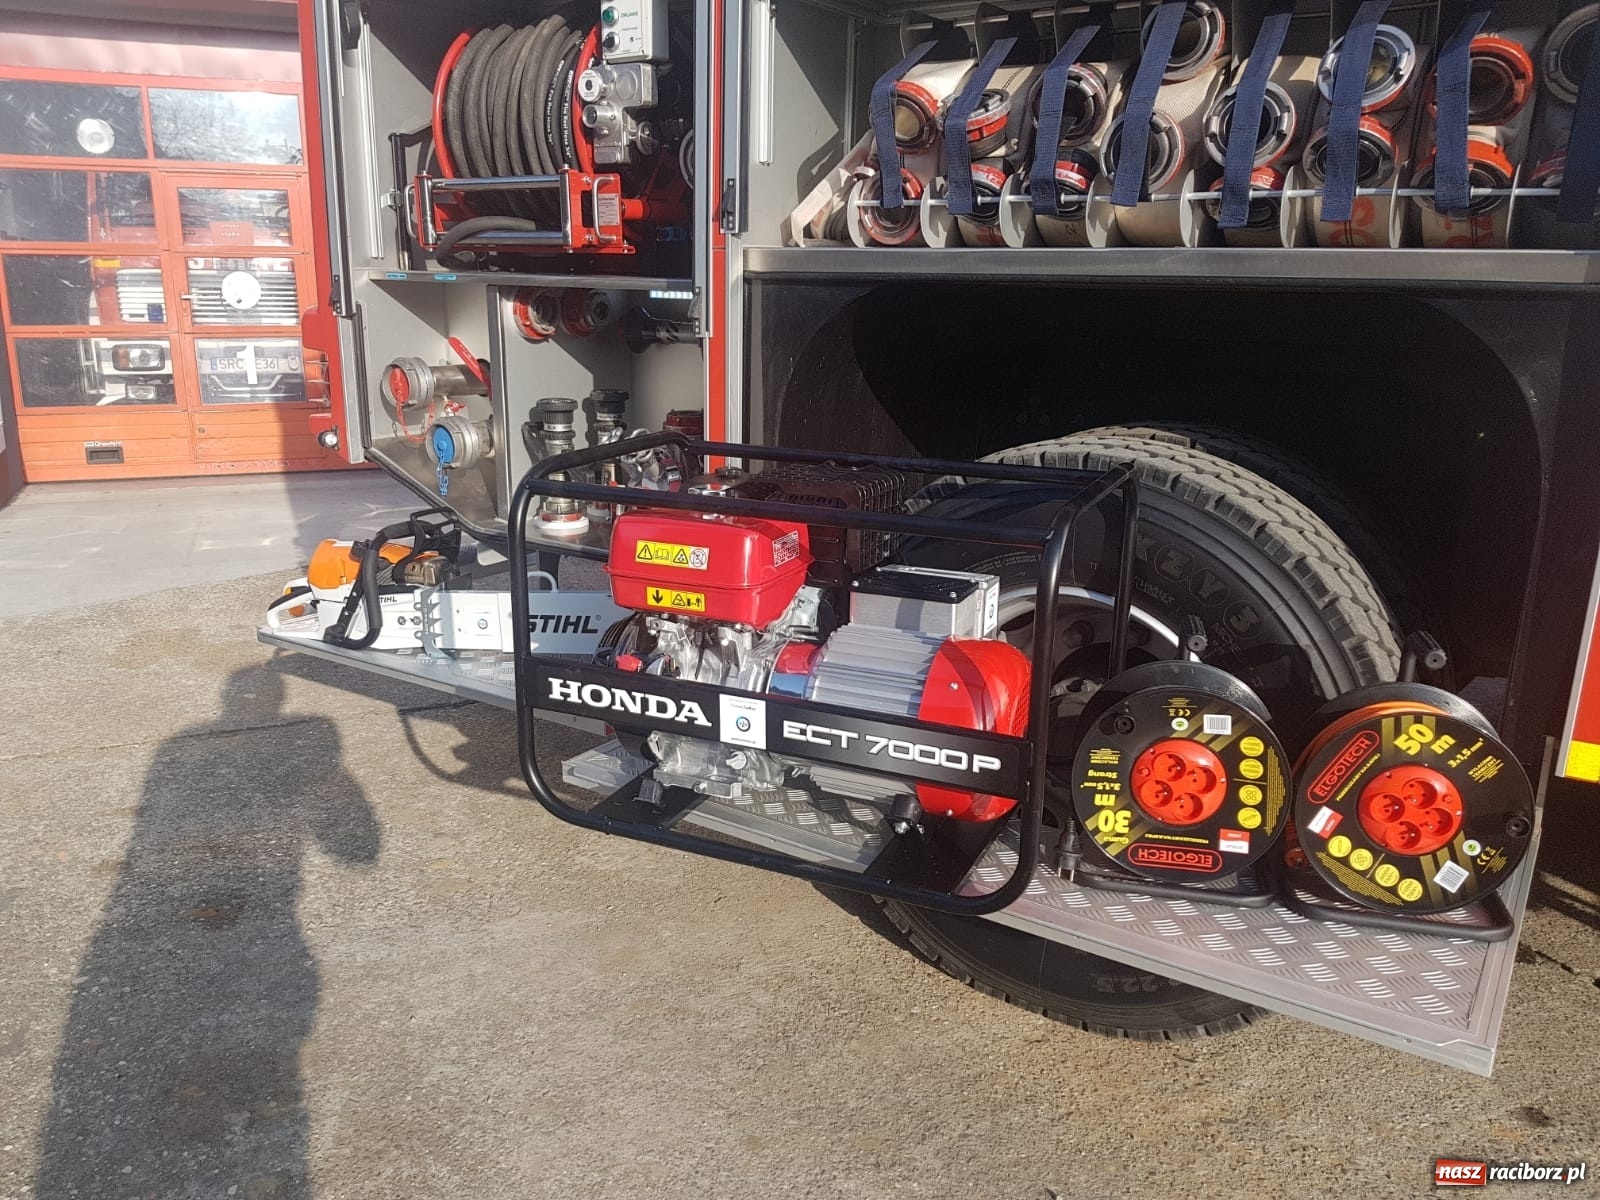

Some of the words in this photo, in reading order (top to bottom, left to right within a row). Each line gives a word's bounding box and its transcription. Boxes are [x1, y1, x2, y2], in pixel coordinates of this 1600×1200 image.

[219, 358, 244, 370] SRC
[236, 344, 258, 385] 1
[377, 594, 397, 603] TIHL
[527, 614, 599, 634] STIHL
[548, 677, 713, 727] HONDA
[783, 719, 859, 749] ECT
[1393, 723, 1434, 755] 50
[1430, 734, 1456, 755] m
[1313, 735, 1372, 797] ELGOTECH
[1094, 793, 1116, 806] m
[1098, 809, 1131, 834] 30
[1103, 836, 1129, 845] Guma
[1134, 848, 1213, 868] ELGOTECH
